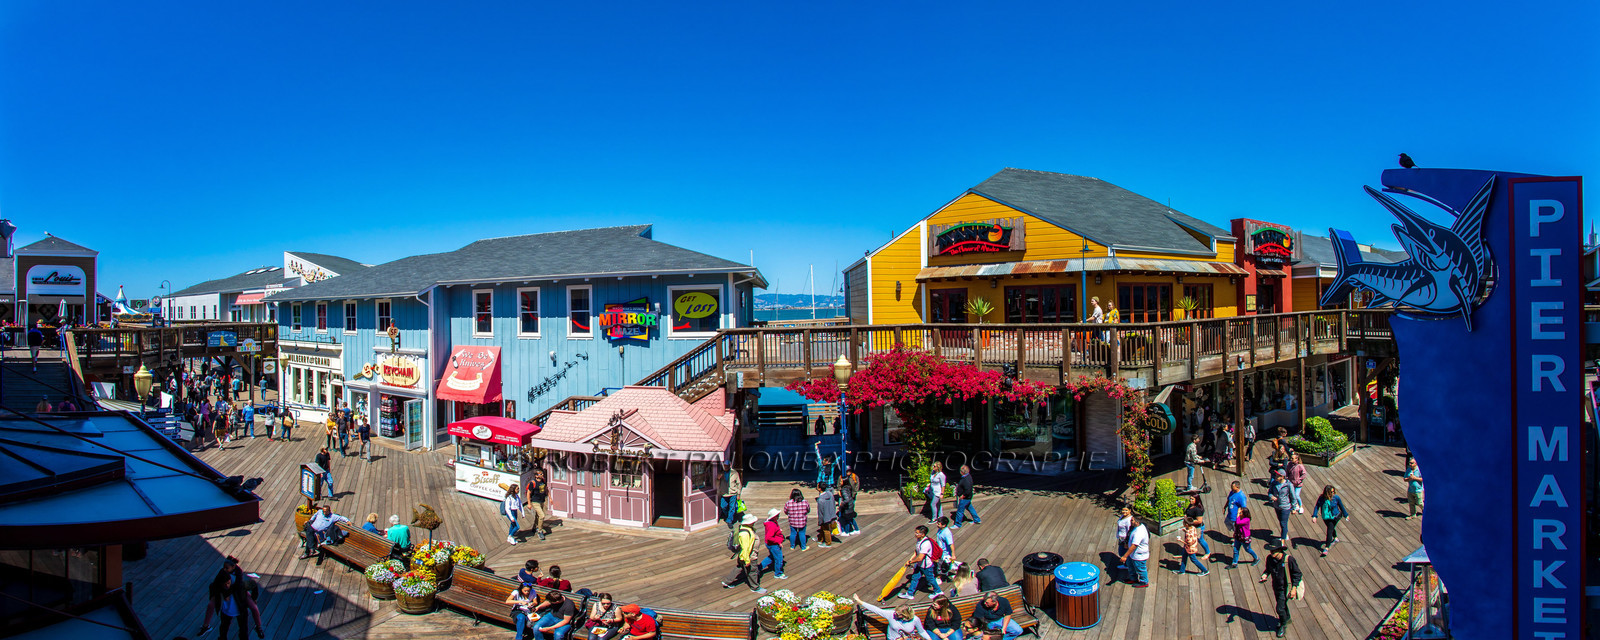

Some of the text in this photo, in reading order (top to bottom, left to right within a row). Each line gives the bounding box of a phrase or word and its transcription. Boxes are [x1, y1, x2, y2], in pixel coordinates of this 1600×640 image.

[43, 271, 81, 282] Louis
[1529, 199, 1567, 393] PIER
[685, 304, 715, 314] LOST
[599, 312, 656, 326] MIRROR
[615, 327, 640, 336] MAZE
[460, 359, 486, 368] Knives
[383, 365, 415, 380] KEYCHAIN
[1144, 416, 1168, 431] GOLD
[472, 473, 501, 485] Biscoff
